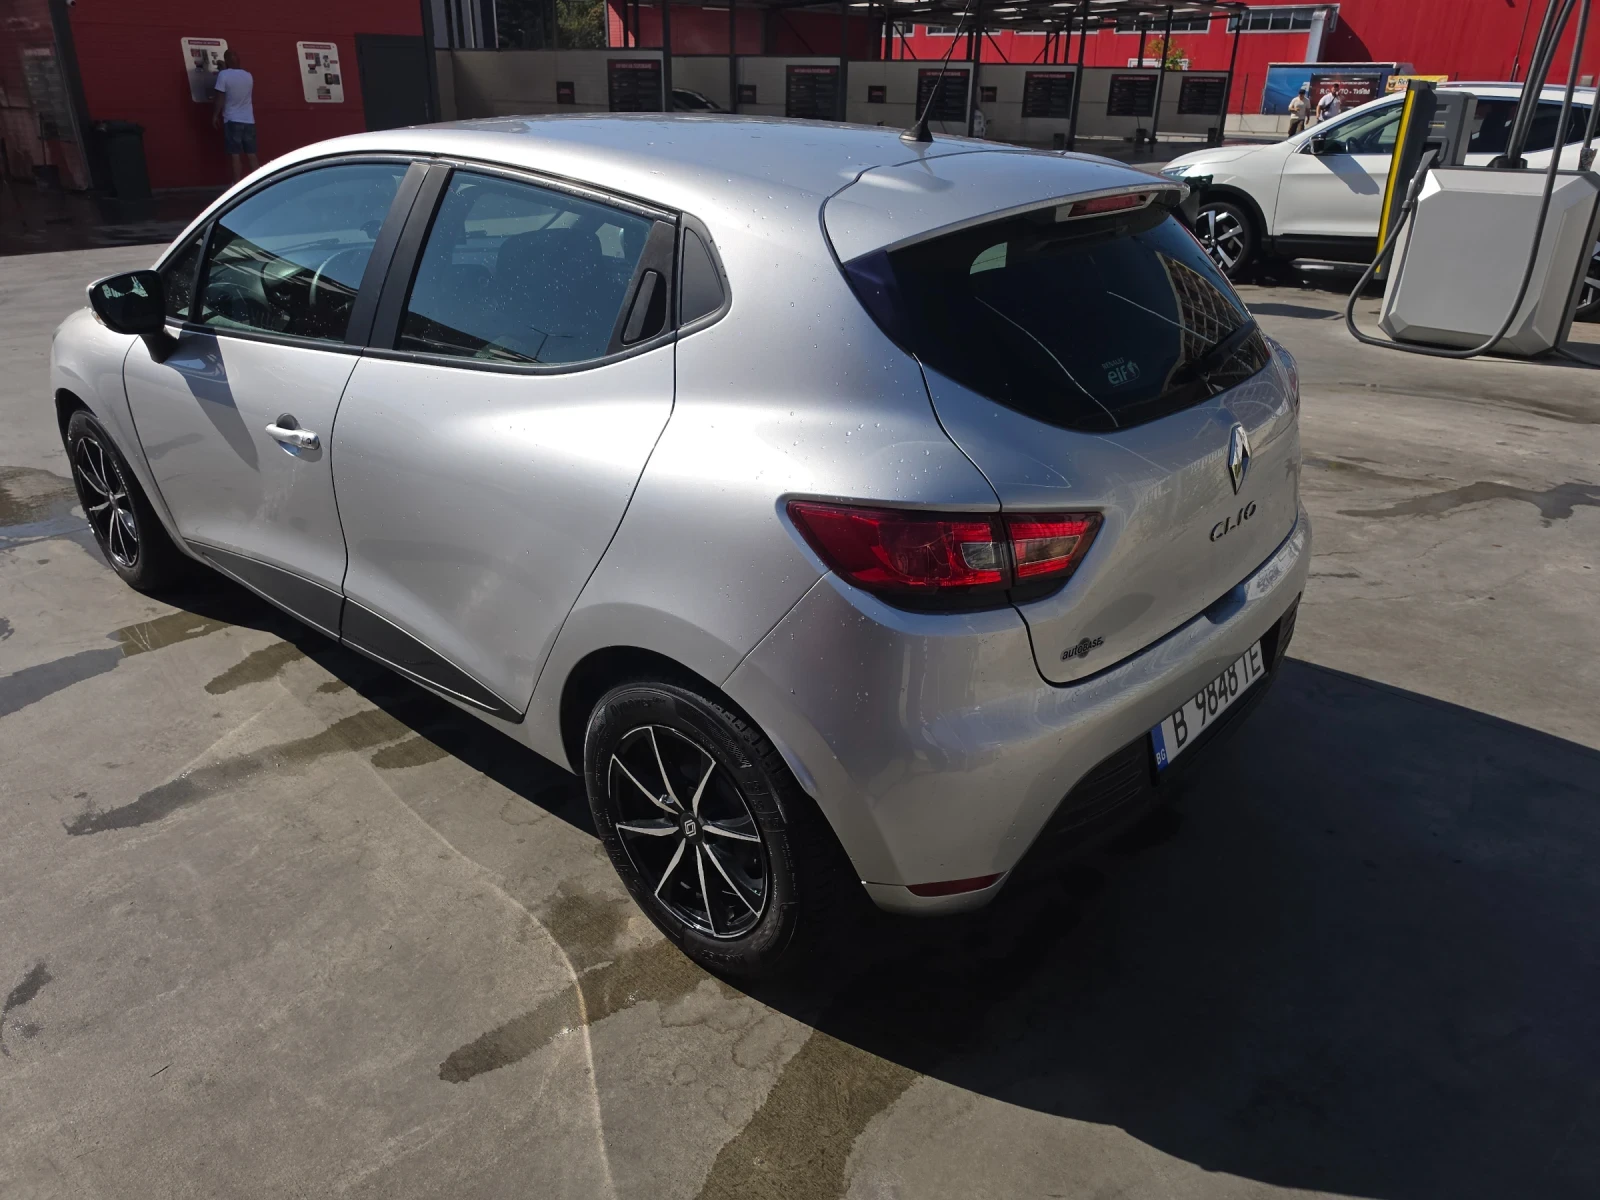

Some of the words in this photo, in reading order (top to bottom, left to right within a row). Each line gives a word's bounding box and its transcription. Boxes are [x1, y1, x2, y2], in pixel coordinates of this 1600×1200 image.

[1108, 365, 1128, 385] elf
[1210, 500, 1256, 542] CLIO
[1172, 704, 1188, 749] B
[1195, 663, 1238, 727] 9848
[1156, 748, 1166, 765] BG
